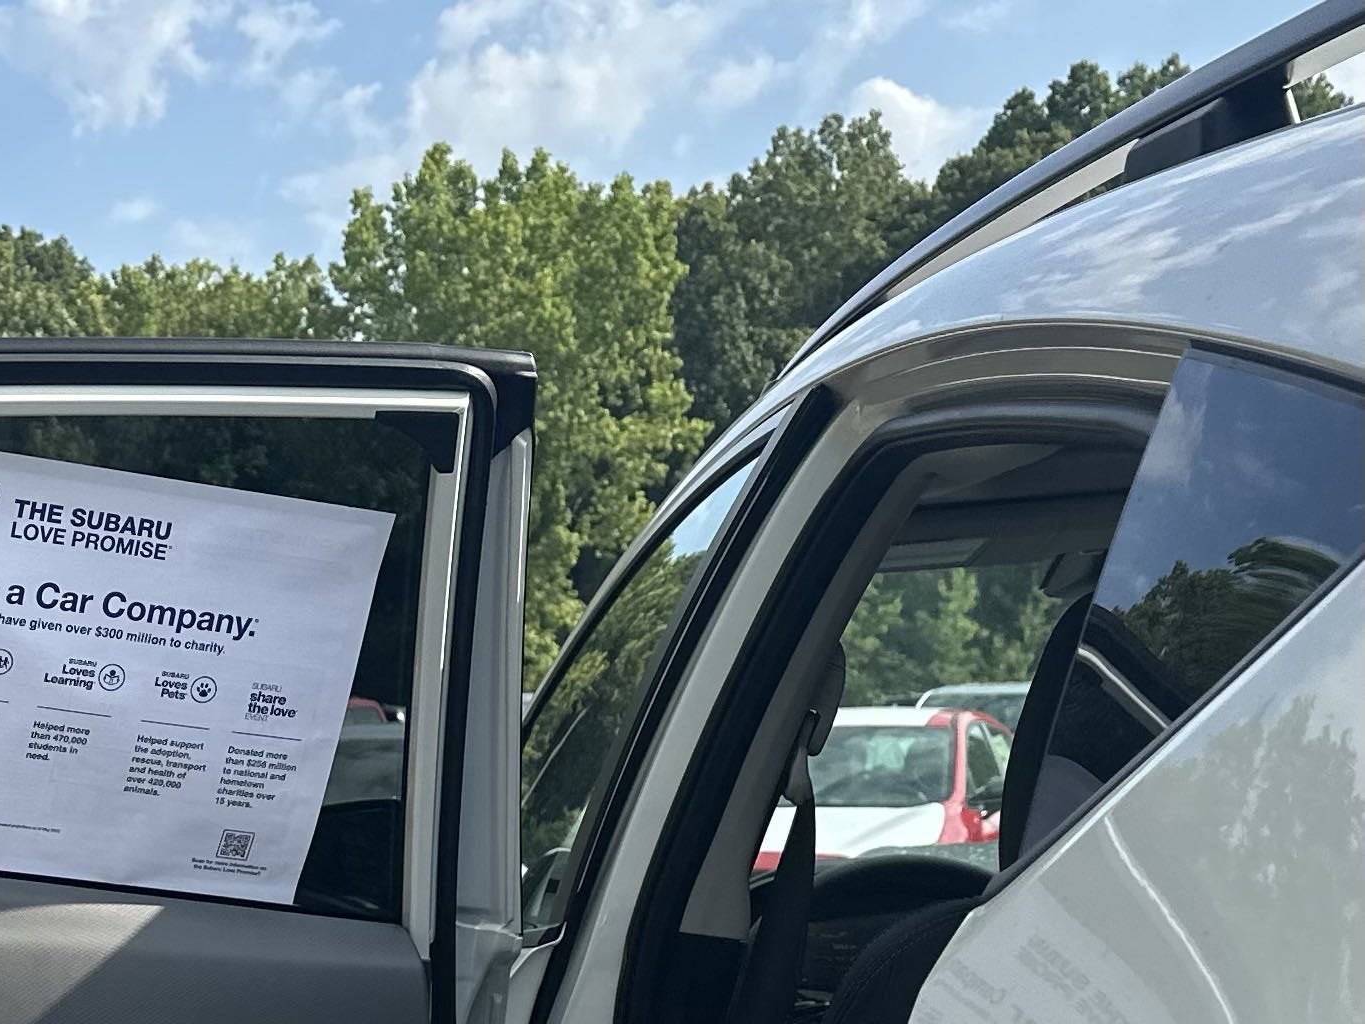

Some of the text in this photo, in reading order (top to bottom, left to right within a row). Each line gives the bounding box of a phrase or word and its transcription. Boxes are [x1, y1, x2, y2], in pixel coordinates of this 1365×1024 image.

[14, 498, 172, 540] THE SUBARU
[10, 521, 167, 560] LOVE PROMISE
[5, 584, 25, 605] a
[35, 582, 94, 613] Car
[28, 617, 62, 631] given
[65, 624, 92, 635] over
[94, 625, 123, 639] $300
[125, 631, 166, 646] million
[169, 636, 181, 648] to
[184, 639, 226, 656] charity.
[61, 663, 95, 677] Loves
[43, 672, 93, 690] Learning
[154, 676, 187, 690] Loves
[160, 687, 186, 700] Pets
[249, 690, 286, 705] share
[247, 701, 297, 717] the love
[32, 720, 90, 735] Helped more
[30, 731, 51, 740] than
[136, 734, 204, 750] Helped support
[27, 741, 78, 754] students in
[134, 744, 191, 760] the adoption,
[227, 745, 288, 760] Donated more
[131, 756, 206, 771] rescue, transport
[225, 756, 244, 765] than
[267, 762, 296, 771] million
[147, 767, 175, 778] health
[232, 769, 268, 779] national
[219, 776, 264, 789] hometown
[123, 785, 160, 796] animals.
[216, 786, 254, 798] charities
[226, 799, 252, 808] years.
